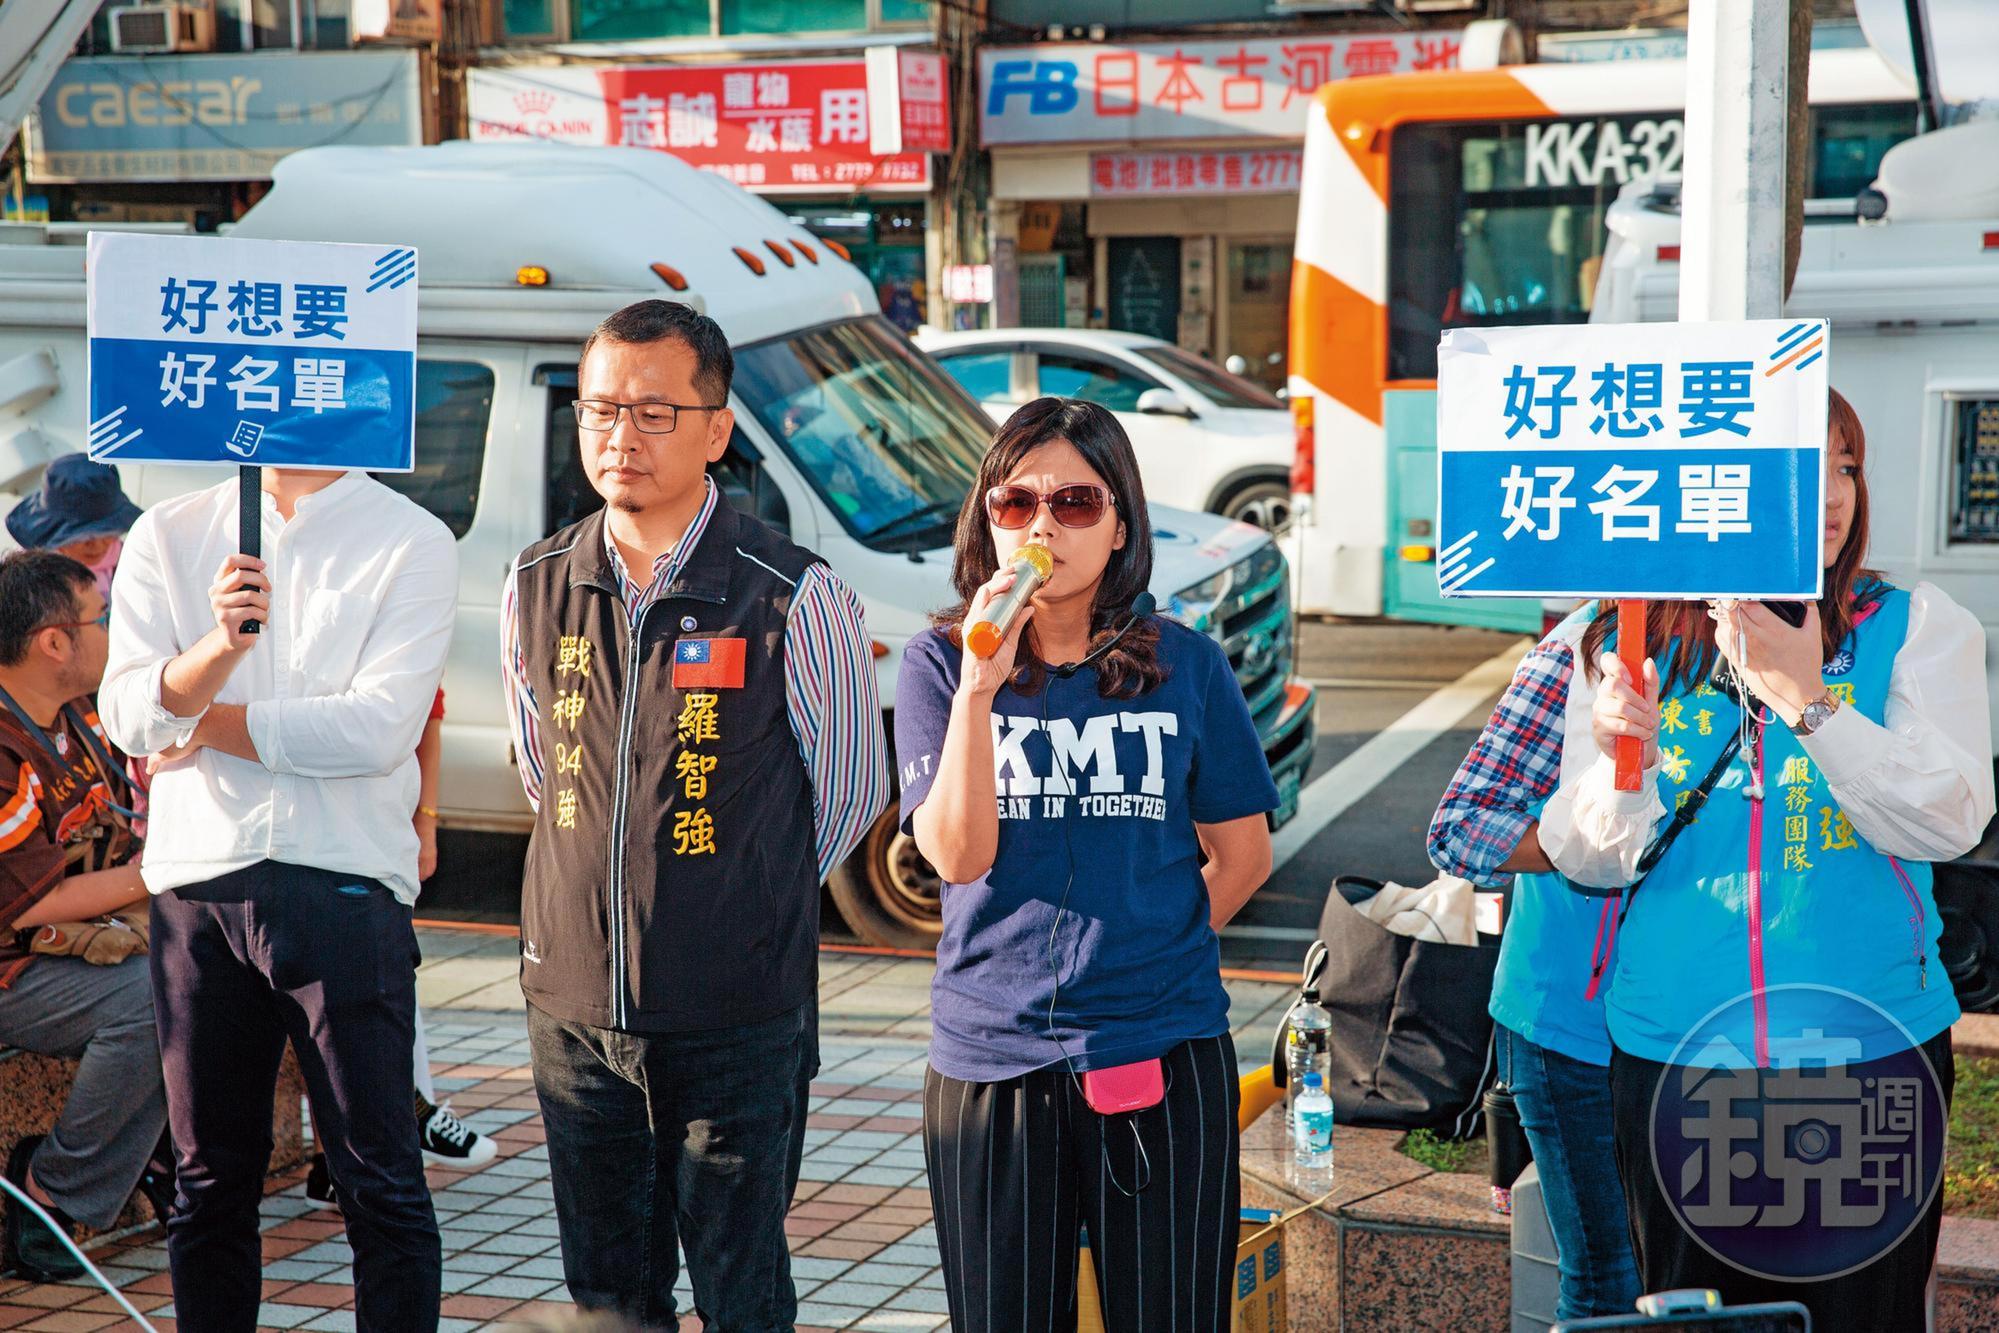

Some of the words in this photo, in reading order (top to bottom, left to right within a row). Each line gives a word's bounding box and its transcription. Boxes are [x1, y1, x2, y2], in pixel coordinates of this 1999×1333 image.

[57, 76, 261, 128] caesar
[819, 88, 869, 145] 用
[987, 60, 1079, 115] FB
[1525, 120, 1684, 187] KKA-32
[160, 277, 348, 341] 好想要
[159, 351, 346, 414] 好名單
[1503, 361, 1755, 440] 好想要
[1500, 463, 1752, 542] 好名單
[553, 635, 591, 830] 戰神94強
[989, 711, 1178, 797] KMT
[673, 693, 721, 856] 羅智強
[997, 797, 1031, 820] EAN
[1043, 796, 1066, 819] IN
[1783, 756, 1814, 872] 服務團隊
